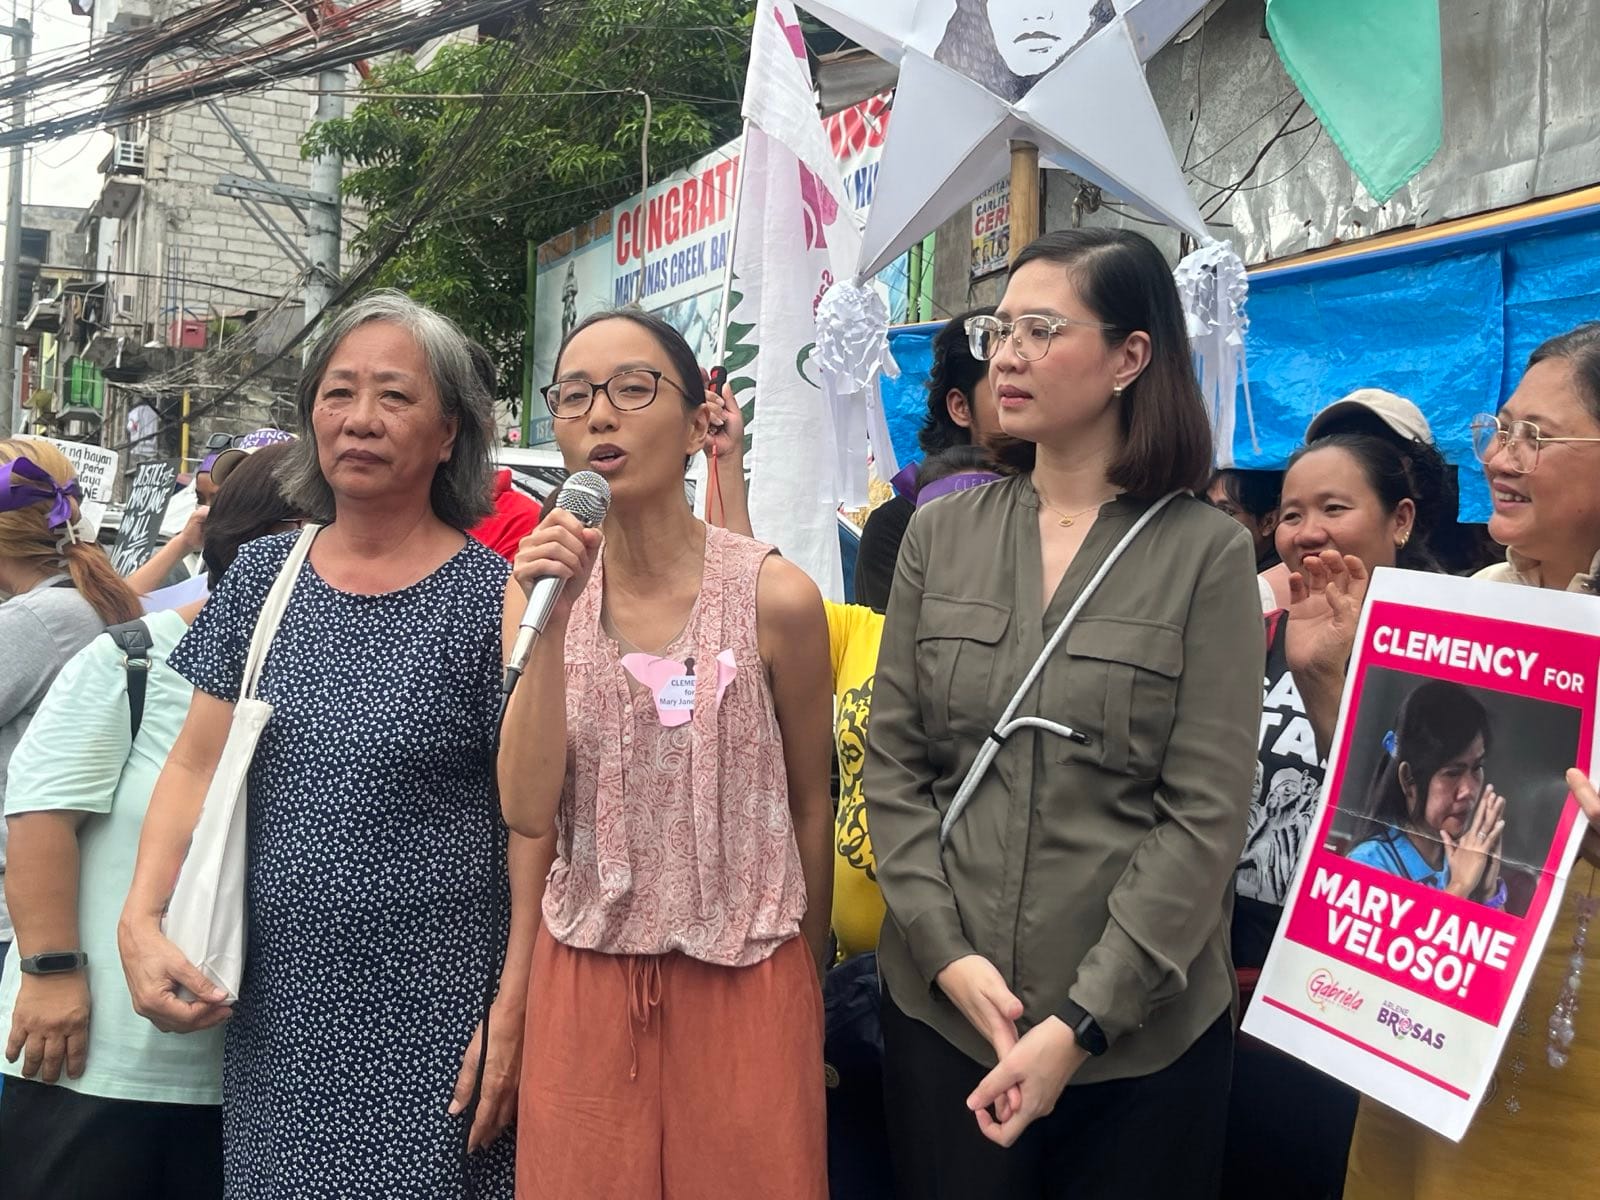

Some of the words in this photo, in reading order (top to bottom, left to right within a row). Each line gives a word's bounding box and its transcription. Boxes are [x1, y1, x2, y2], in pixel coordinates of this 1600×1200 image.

[617, 155, 741, 266] CONGRAT
[710, 230, 731, 271] BA
[1372, 625, 1539, 681] CLEMENCY
[1543, 668, 1585, 693] FOR
[659, 698, 677, 706] Mary
[1309, 866, 1414, 928] MARY
[1415, 909, 1517, 970] JANE
[1326, 909, 1477, 998] VELOSO!
[1309, 974, 1364, 1010] Gabriela
[1376, 1006, 1446, 1050] BROSAS
